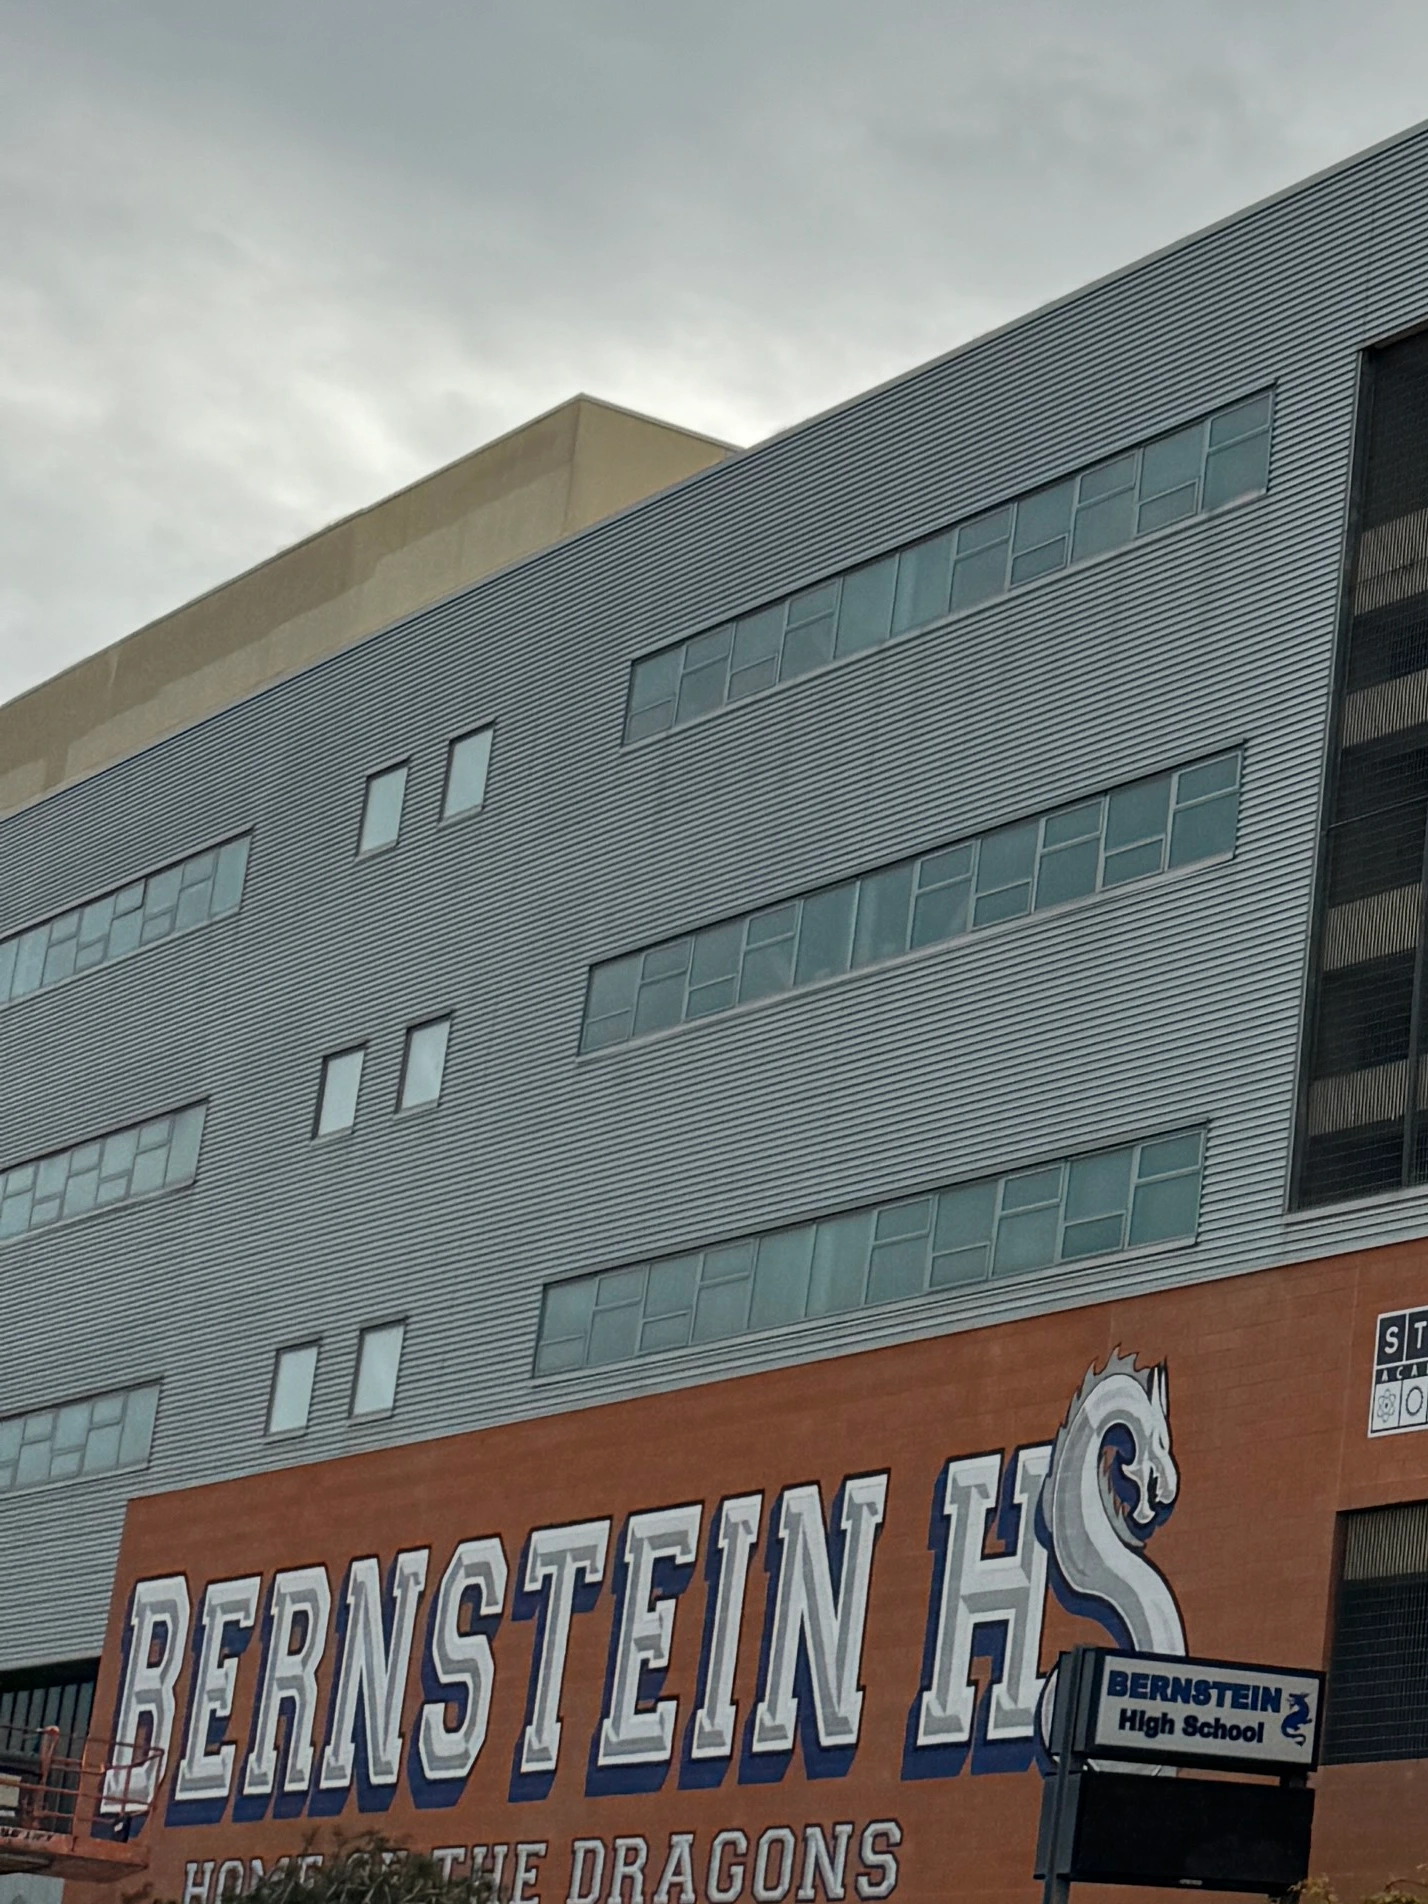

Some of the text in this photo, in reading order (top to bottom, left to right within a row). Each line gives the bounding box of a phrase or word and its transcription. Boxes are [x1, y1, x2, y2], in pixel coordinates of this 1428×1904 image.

[98, 1468, 890, 1834] BERNSTEIN
[1107, 1670, 1282, 1713] BERNSTEIN
[1119, 1708, 1265, 1743] High School
